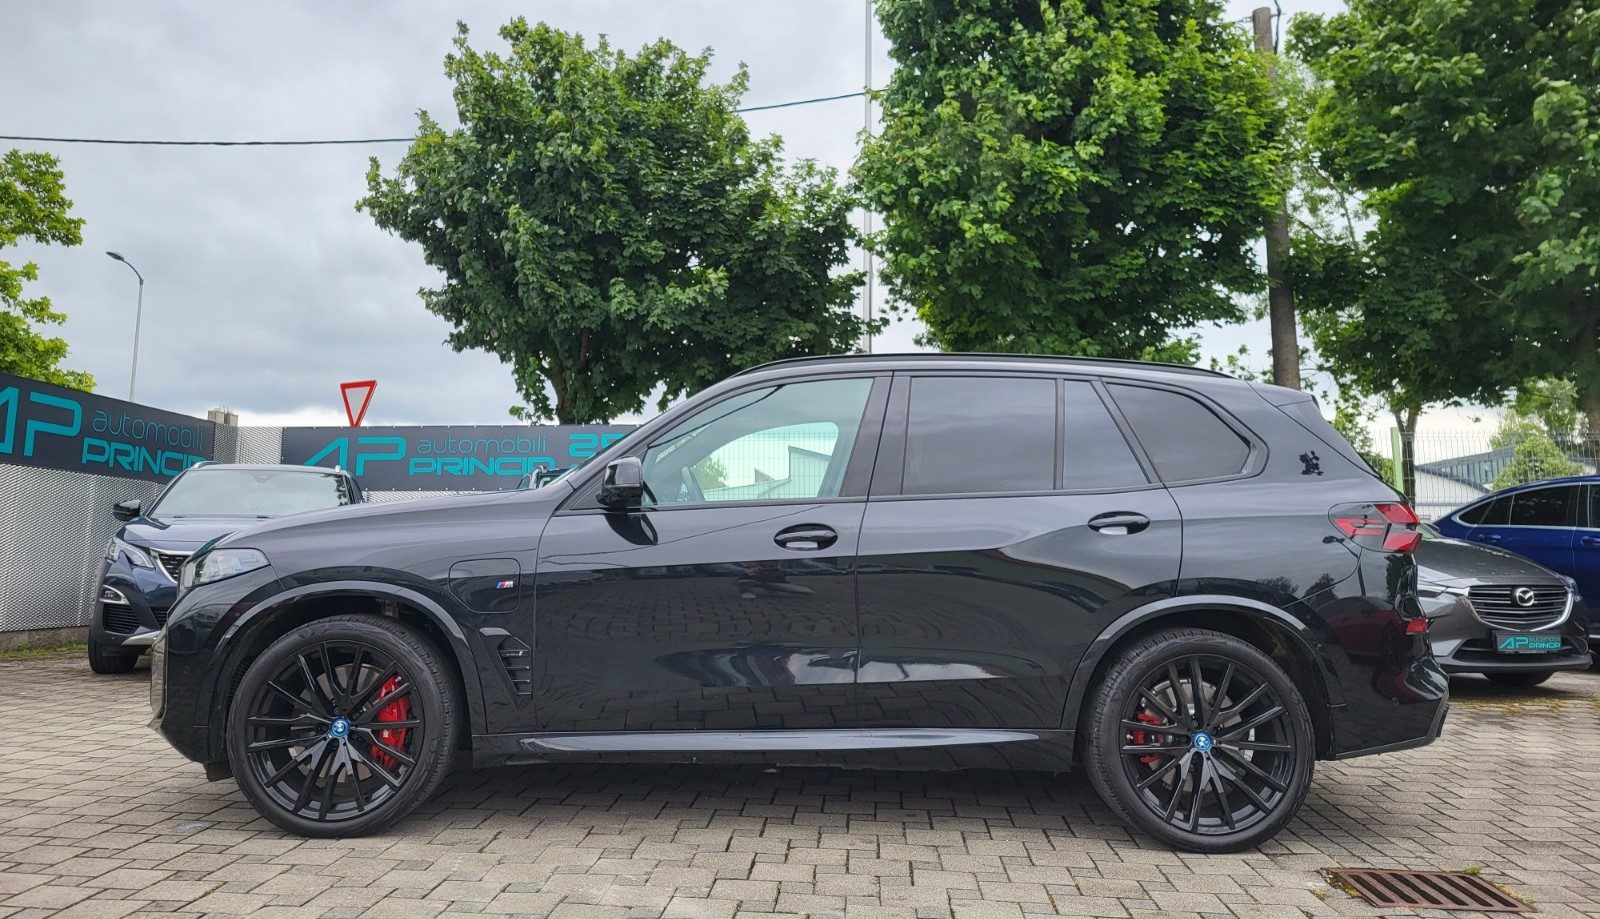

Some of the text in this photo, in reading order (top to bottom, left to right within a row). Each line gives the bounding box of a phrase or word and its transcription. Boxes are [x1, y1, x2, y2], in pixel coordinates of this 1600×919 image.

[92, 409, 203, 451] automobili
[417, 435, 547, 454] automobili
[303, 436, 407, 477] AP
[1499, 635, 1529, 649] AP
